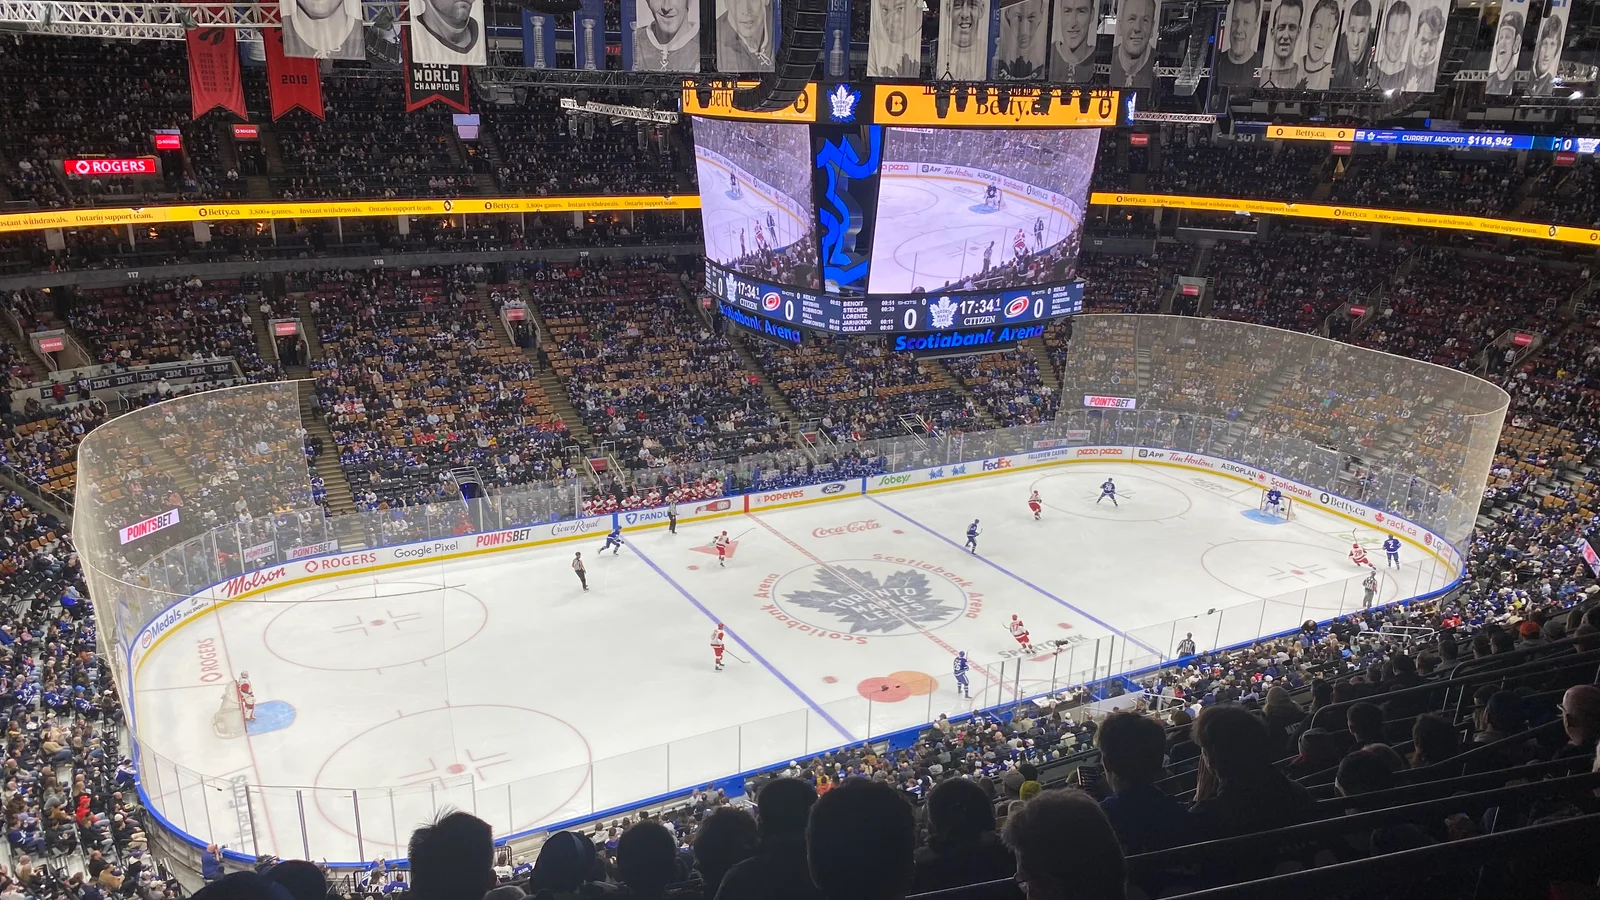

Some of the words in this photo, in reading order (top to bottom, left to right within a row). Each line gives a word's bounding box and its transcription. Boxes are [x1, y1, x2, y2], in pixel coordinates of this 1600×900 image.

[282, 75, 308, 84] 2019
[414, 70, 459, 83] WORLD
[414, 83, 460, 91] CHAMPIONS
[1237, 134, 1256, 142] 301
[1434, 136, 1466, 144] JACKPOT:
[1468, 136, 1513, 147] $118,942
[1564, 139, 1572, 150] 0
[92, 160, 146, 172] ROGERS
[208, 208, 240, 217] Betty.ca
[493, 202, 519, 210] Betty.ca
[738, 281, 756, 299] 17:34
[740, 298, 757, 310] CITIZEN
[785, 300, 794, 320] 0
[960, 299, 994, 314] 17:34
[1034, 298, 1043, 318] 0
[718, 300, 762, 332] Scotiabank
[764, 320, 800, 342] Arena
[904, 308, 917, 330] 0
[964, 315, 996, 326] CITIZEN
[895, 328, 995, 350] Scotiabank
[998, 324, 1044, 342] Arena
[165, 370, 182, 378] IBM
[189, 366, 206, 375] IBM
[213, 363, 229, 372] IBM
[93, 379, 110, 389] IBM
[116, 375, 134, 384] IBM
[140, 372, 158, 382] IBM
[1089, 397, 1130, 408] POINTSBET
[1028, 450, 1050, 459] FALLSVIEW
[1077, 449, 1098, 457] pizza
[1168, 452, 1183, 462] Tim
[1182, 454, 1214, 468] Hortons
[982, 458, 1012, 471] FedEx
[1221, 462, 1256, 478] AEROPLAN
[879, 474, 911, 486] Sobeys
[824, 485, 844, 494] Ford
[1271, 477, 1313, 499] Scotiabank
[1330, 498, 1366, 517] Betty.ca
[127, 512, 172, 541] POINTSBET
[551, 522, 576, 536] Crown
[574, 518, 600, 534] Royal
[812, 519, 883, 538] Coca-Cola
[1386, 518, 1417, 536] rack.ca
[476, 528, 531, 547] POINTSBET
[292, 542, 332, 558] POINTSBET
[394, 544, 431, 560] Google
[434, 541, 459, 553] Pixel
[322, 553, 376, 569] ROGERS
[221, 567, 286, 598] Molson
[754, 573, 780, 599] Arena
[872, 553, 973, 588] Scotiabank
[965, 591, 984, 620] Arena
[151, 609, 182, 638] Medals
[760, 604, 868, 645] Scotiabank
[198, 638, 218, 673] ROGERS
